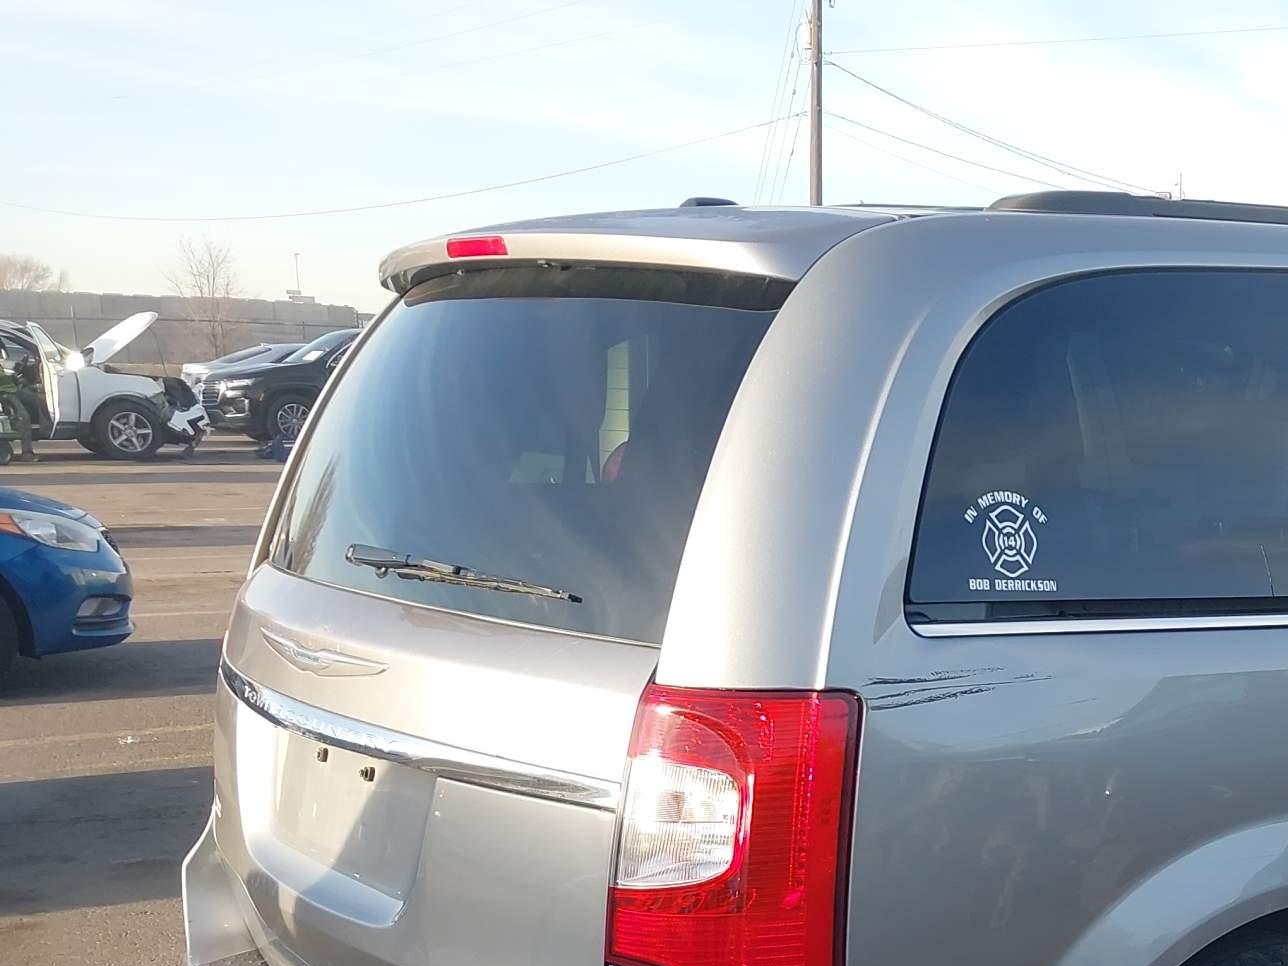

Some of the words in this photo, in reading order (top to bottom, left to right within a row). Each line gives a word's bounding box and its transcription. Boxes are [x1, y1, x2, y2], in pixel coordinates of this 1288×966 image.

[964, 506, 978, 524] IN
[977, 490, 1029, 509] MEMORY
[1032, 506, 1048, 524] OF
[1004, 536, 1016, 547] 14
[969, 578, 990, 590] BOB
[995, 579, 1057, 592] DERRICKSON
[244, 685, 270, 711] TOWN
